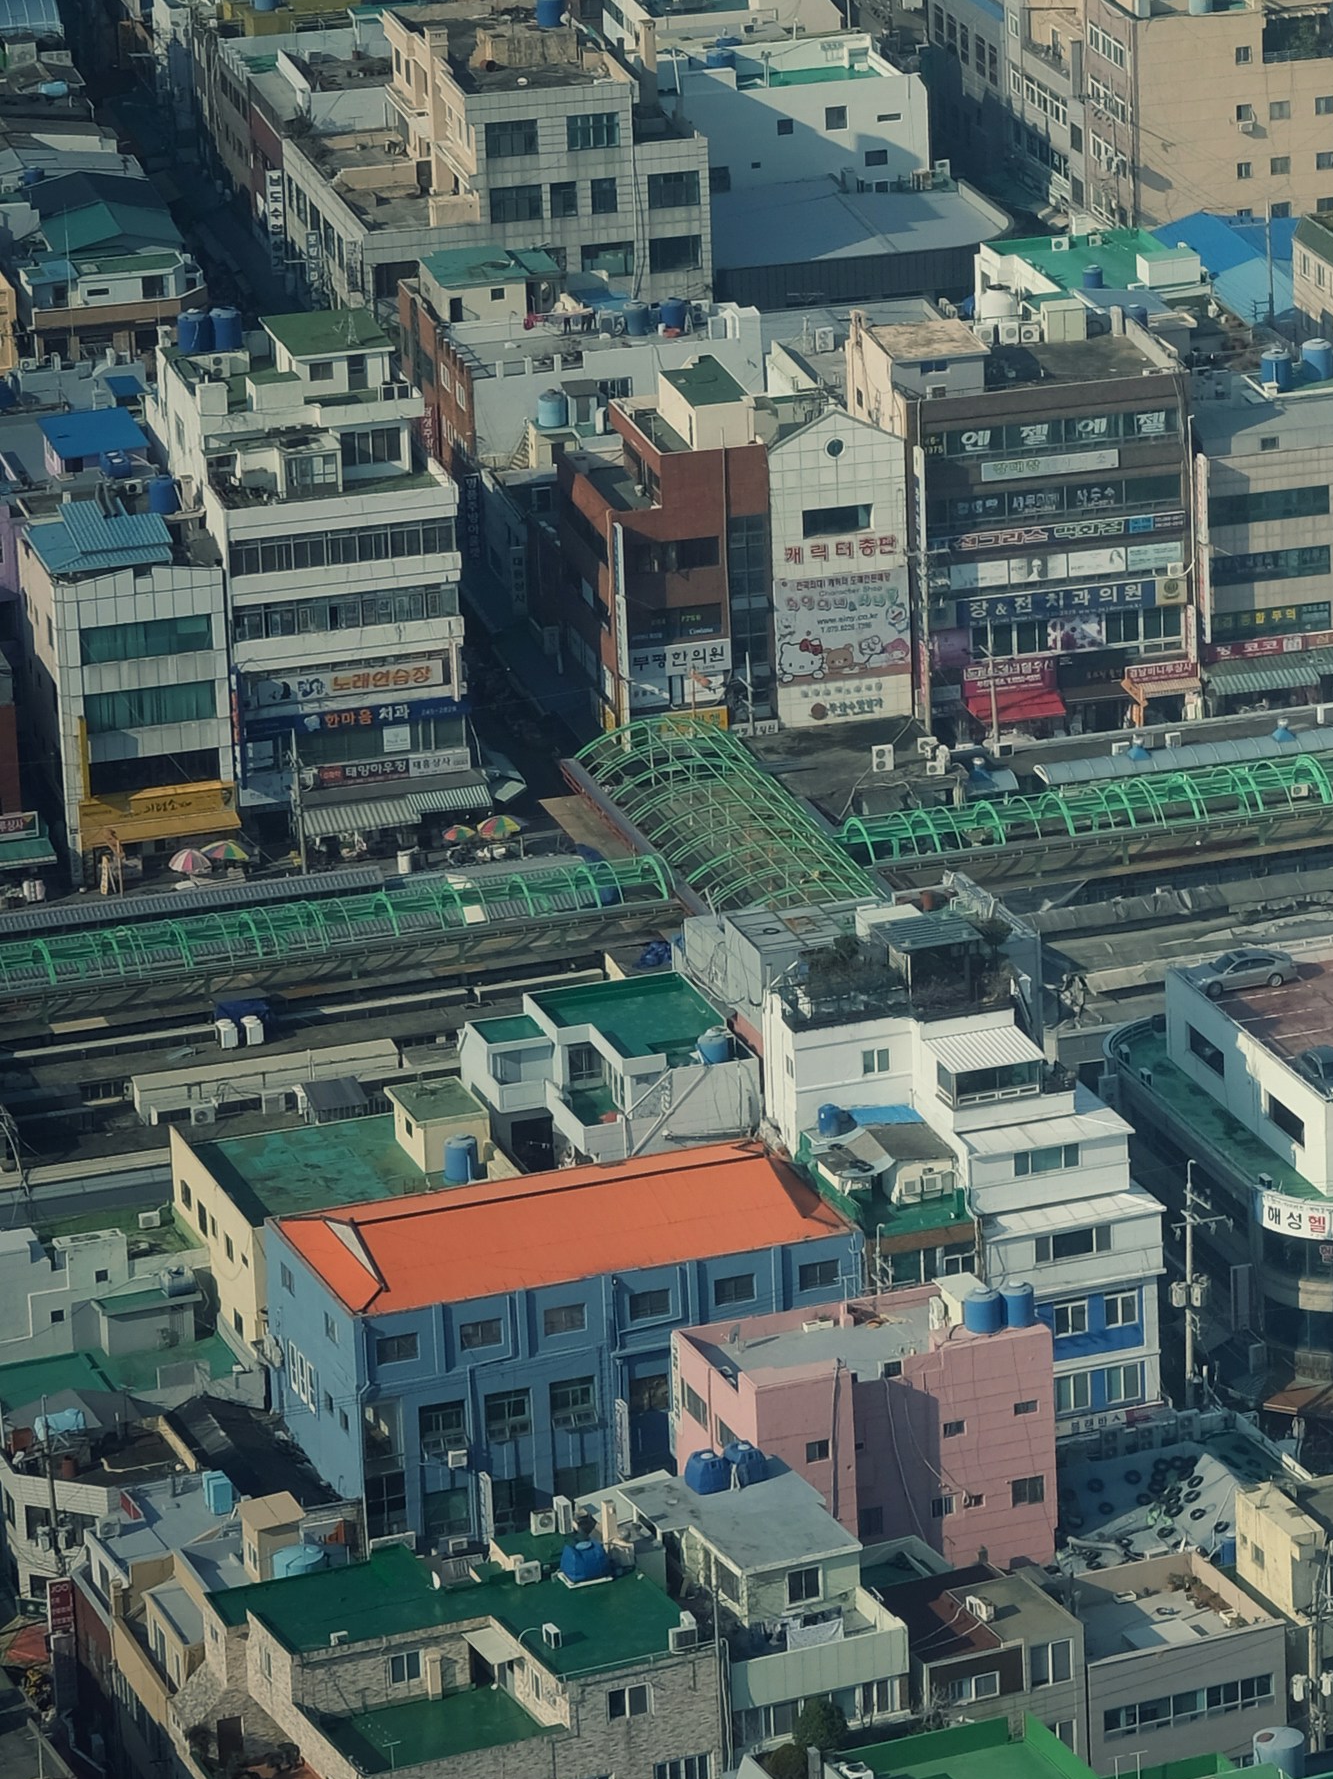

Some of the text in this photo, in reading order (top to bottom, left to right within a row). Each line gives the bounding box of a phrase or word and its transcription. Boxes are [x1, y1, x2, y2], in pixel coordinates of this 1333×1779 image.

[784, 535, 899, 566] 캐릭터총판
[1014, 594, 1033, 614] 전
[1045, 582, 1143, 609] 치과의원
[632, 644, 727, 672] 부평한의원
[332, 665, 433, 693] 노래연습장
[325, 708, 374, 730] 한마음
[379, 703, 411, 722] 치과
